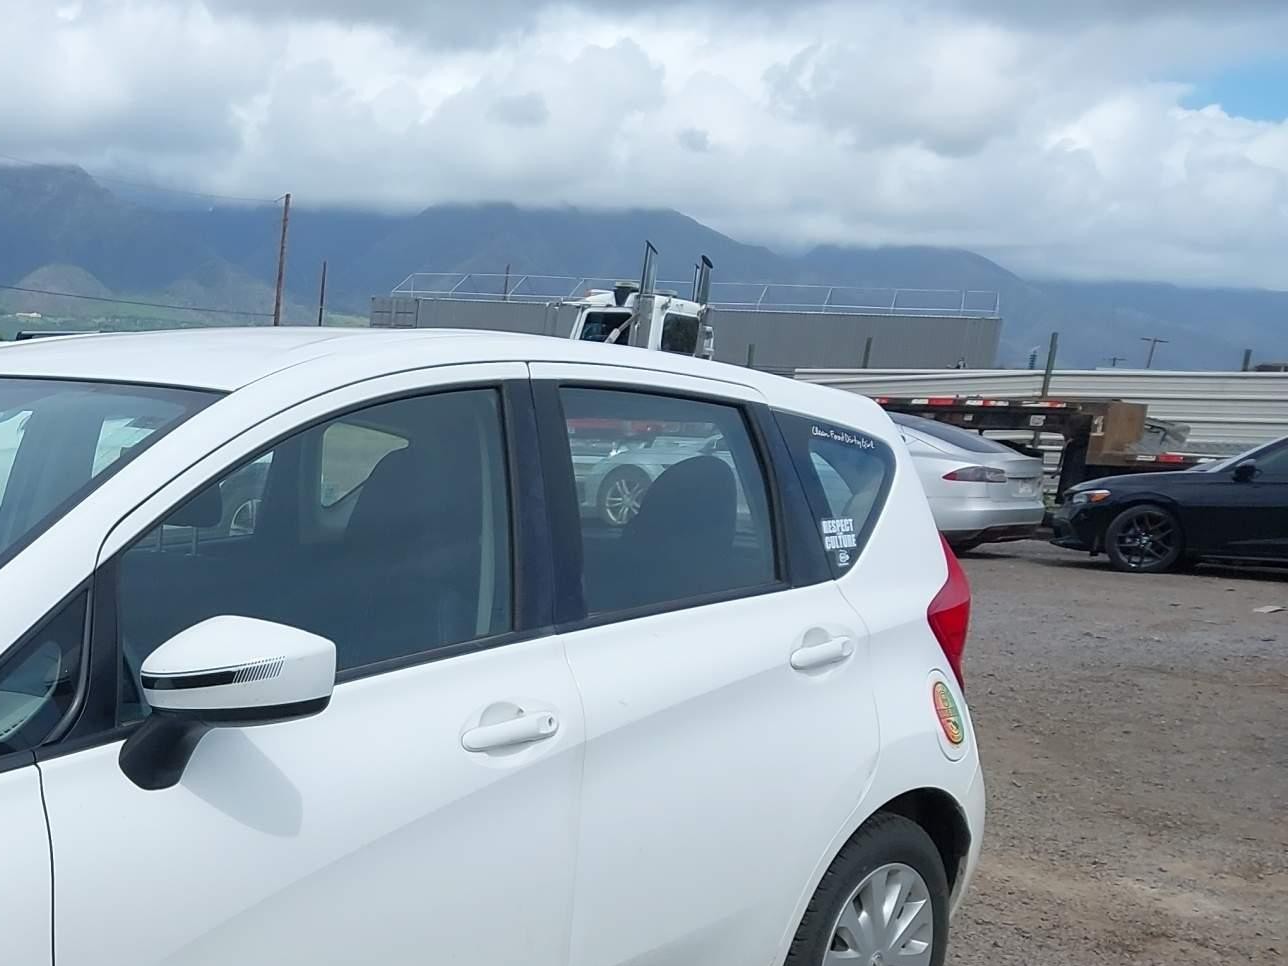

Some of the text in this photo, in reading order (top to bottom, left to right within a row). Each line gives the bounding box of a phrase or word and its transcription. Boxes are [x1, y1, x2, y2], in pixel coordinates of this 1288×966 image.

[830, 430, 844, 442] Food
[822, 519, 854, 534] RESPECT
[825, 535, 857, 550] CULTURE
